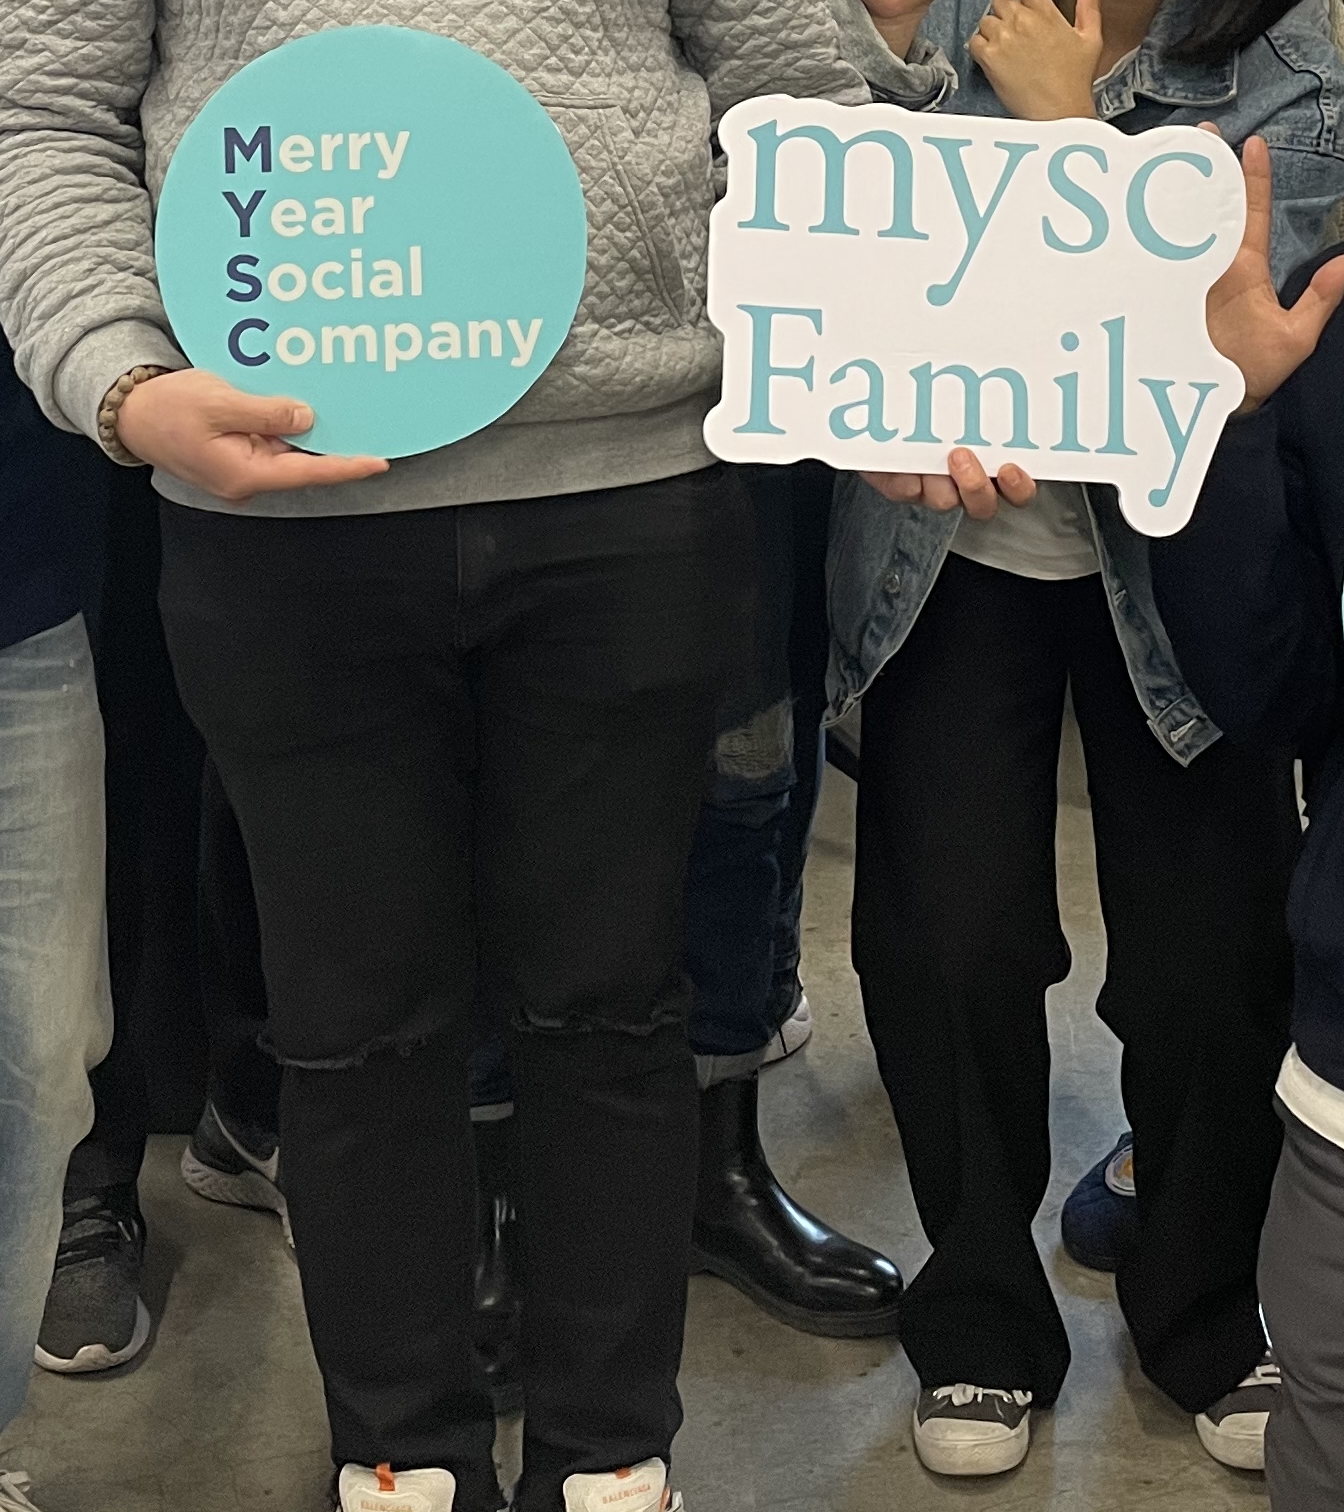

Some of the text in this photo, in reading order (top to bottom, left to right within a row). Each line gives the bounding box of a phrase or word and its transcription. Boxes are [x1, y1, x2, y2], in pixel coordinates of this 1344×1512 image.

[223, 125, 411, 179] Merry
[221, 189, 375, 238] Year
[737, 119, 1218, 307] mysc
[225, 245, 424, 303] Social
[227, 317, 544, 372] Company
[732, 304, 1220, 508] Family
